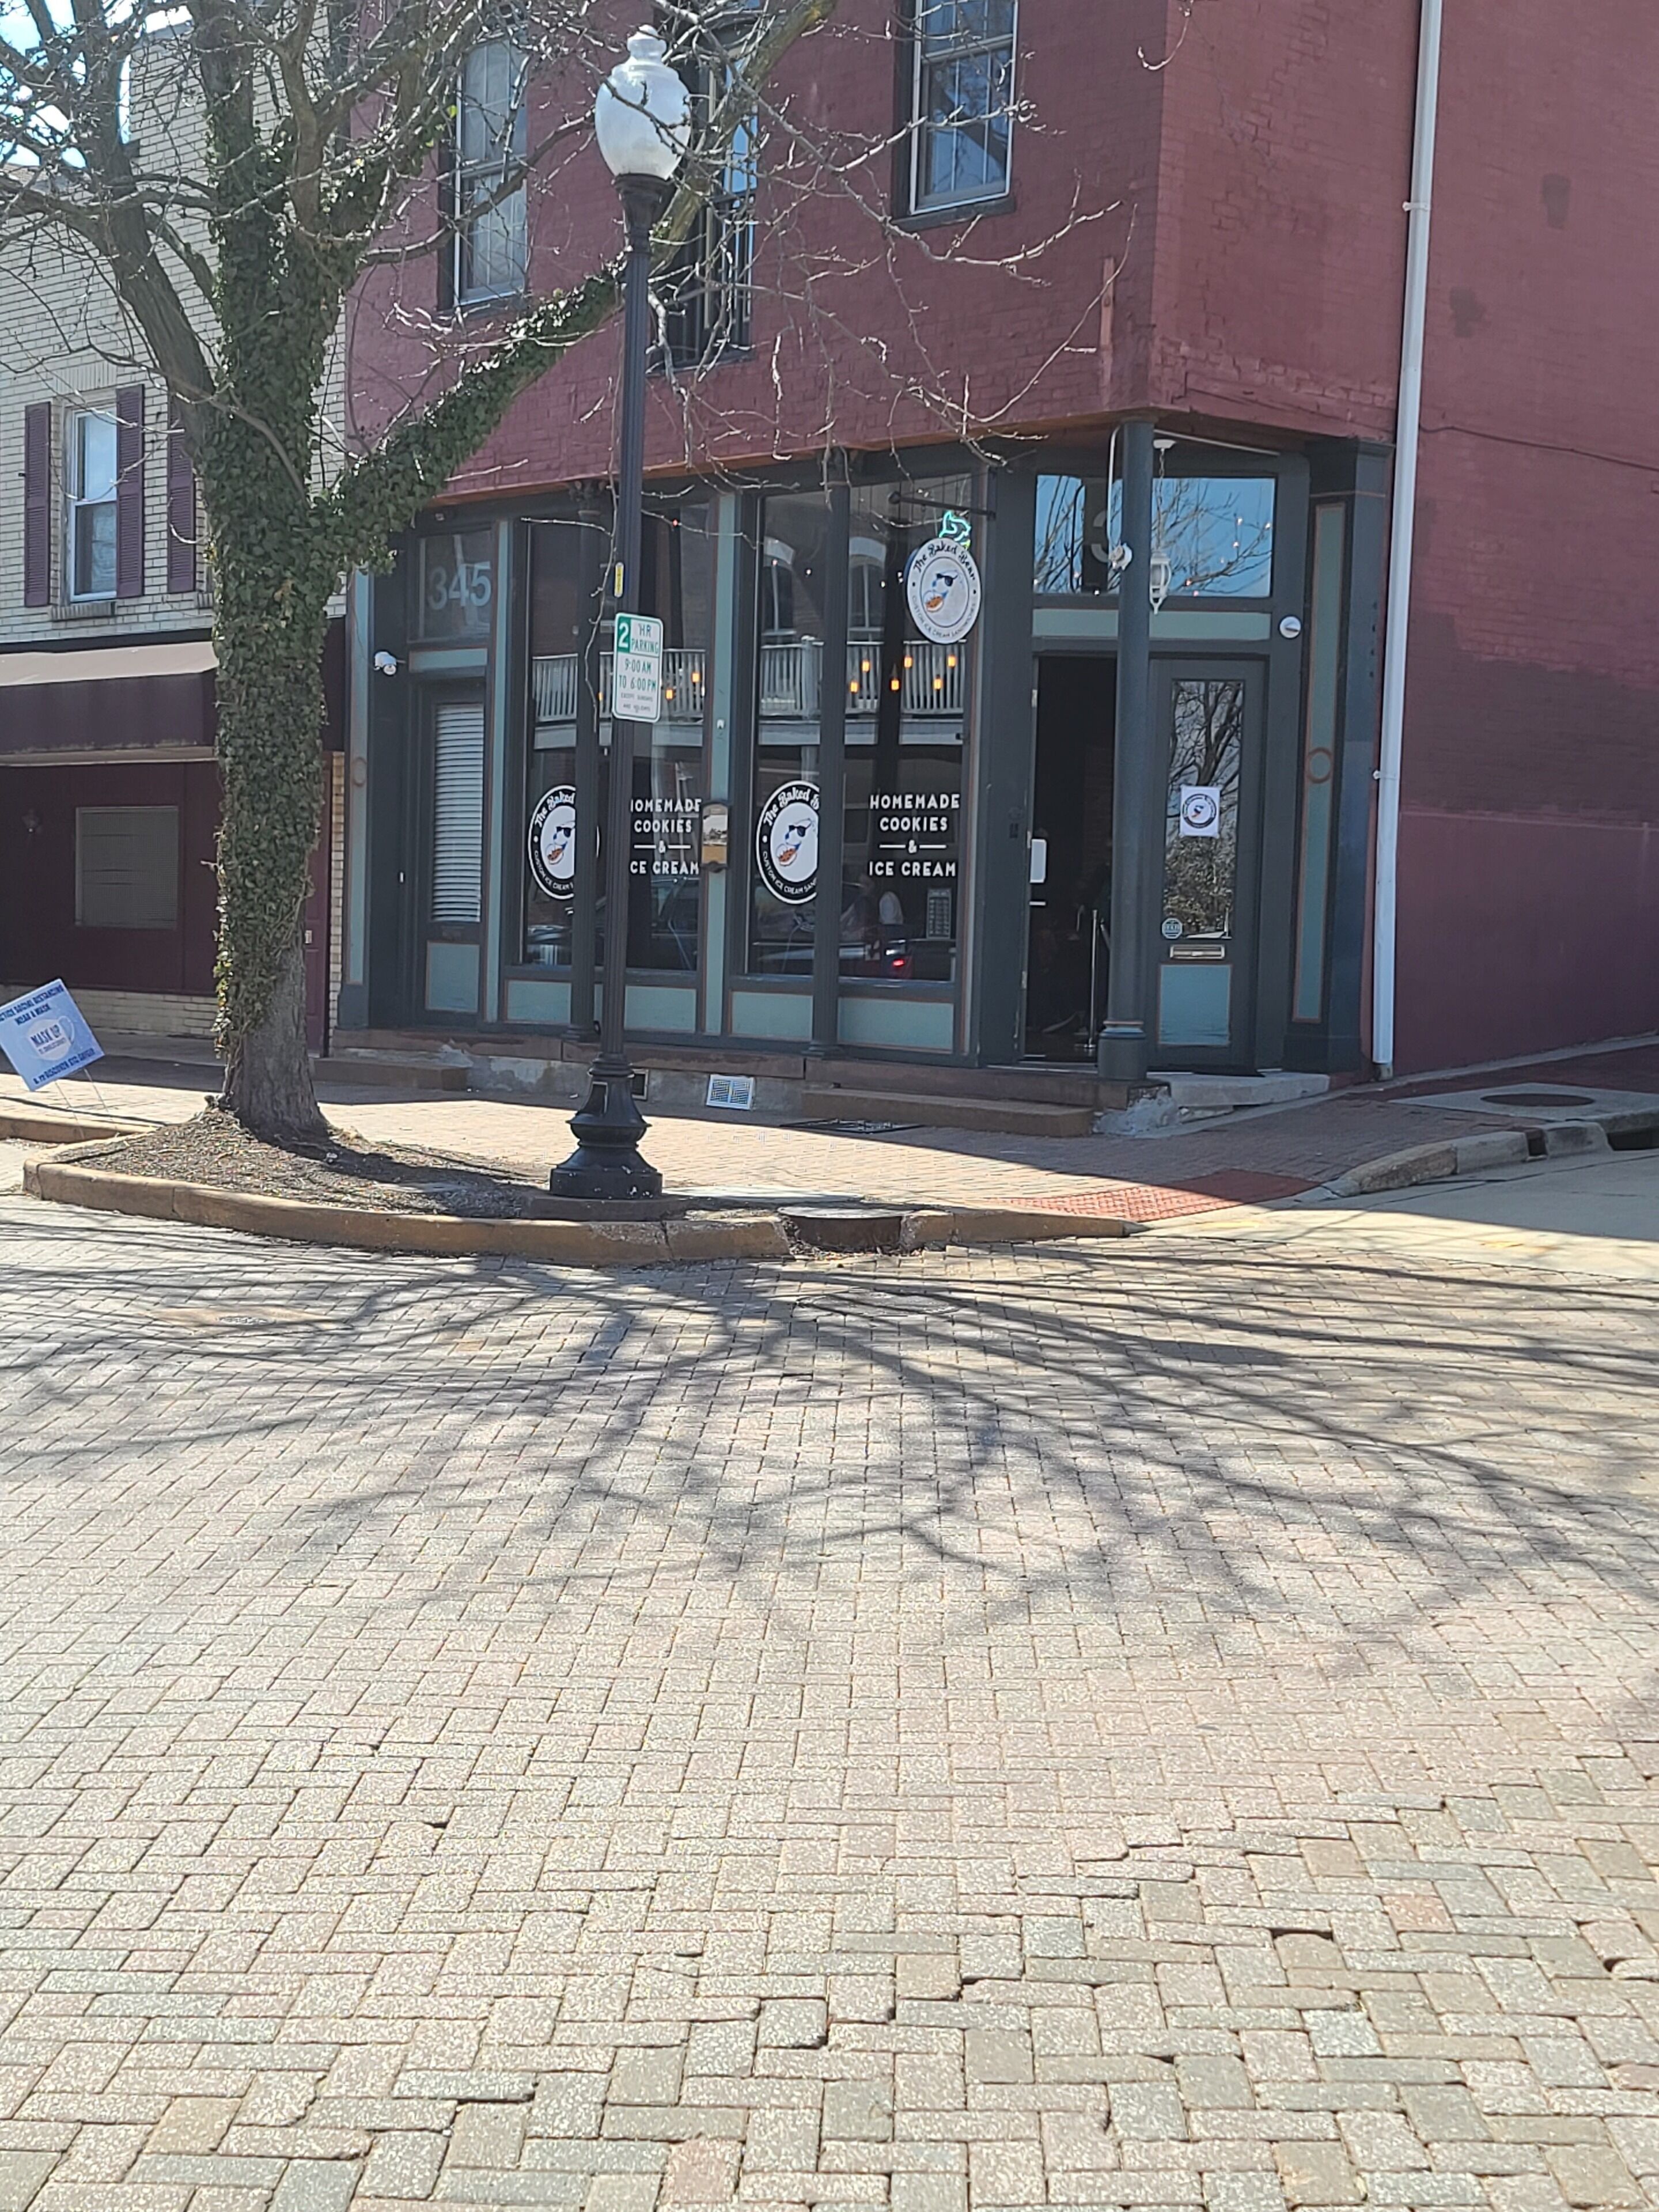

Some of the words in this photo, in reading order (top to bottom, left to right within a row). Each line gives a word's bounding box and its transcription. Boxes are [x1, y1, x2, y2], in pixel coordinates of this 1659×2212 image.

[914, 554, 928, 573] The
[927, 540, 958, 557] Baked
[958, 551, 976, 581] Bear
[427, 561, 492, 610] 345
[618, 622, 630, 648] 2
[638, 623, 652, 638] HR
[932, 630, 950, 639] CREAM
[631, 638, 659, 654] PARKING
[624, 658, 641, 673] 9:00
[641, 660, 652, 675] AM
[619, 675, 627, 689] TO
[630, 677, 646, 691] 6:00
[647, 679, 657, 693] PM
[535, 806, 548, 828] The
[547, 790, 575, 810] Baked
[763, 804, 779, 826] The
[777, 786, 811, 808] Baked
[869, 794, 961, 809] HOMEMADE
[634, 819, 692, 833] COOKIES
[880, 817, 948, 832] COOKIES
[658, 840, 666, 854] &
[907, 839, 917, 853] &
[534, 850, 547, 879] CUSTOM
[544, 876, 553, 888] ICE
[630, 861, 647, 874] CE
[652, 861, 700, 875] CREAM
[763, 851, 777, 881] CUSTOM
[775, 879, 784, 891] ICE
[783, 885, 803, 894] CREAM
[869, 861, 894, 876] ICE
[902, 861, 956, 876] CREAM
[31, 1030, 52, 1047] MASK
[50, 1024, 61, 1039] UP
